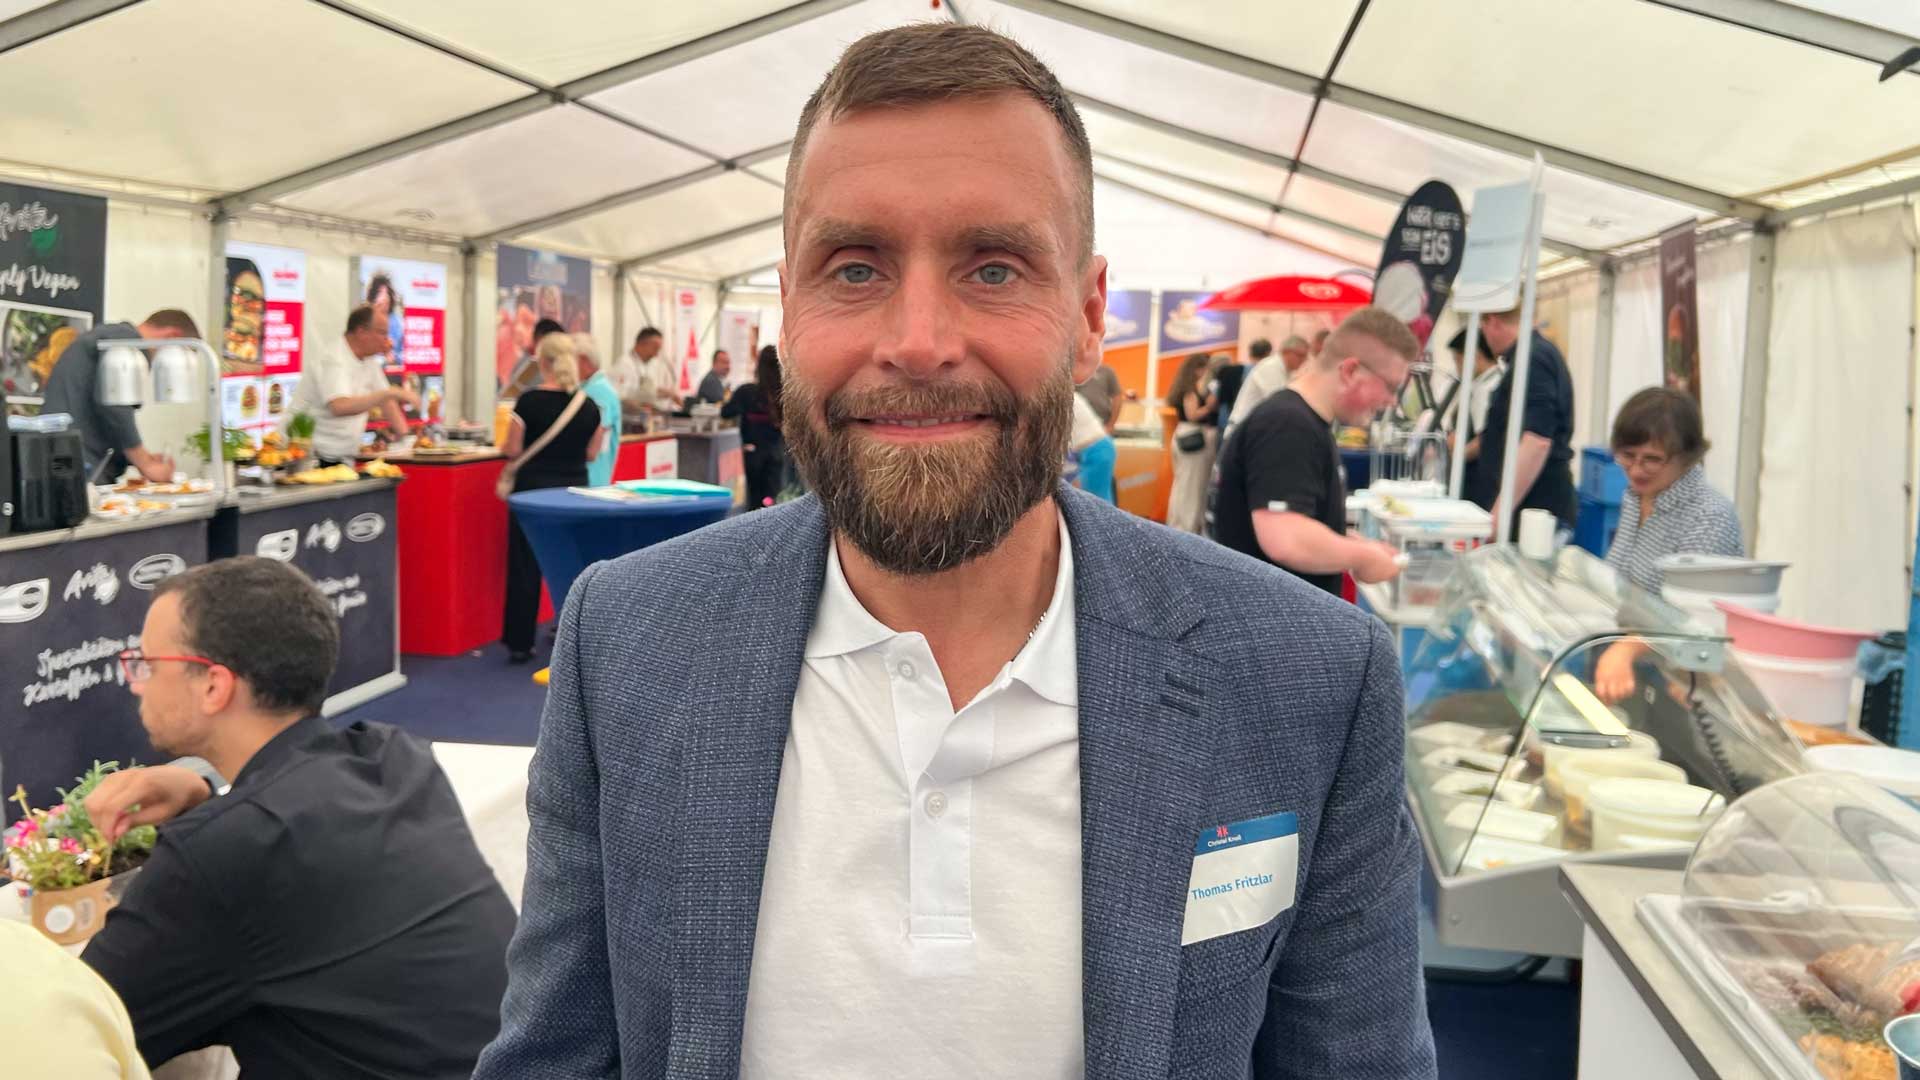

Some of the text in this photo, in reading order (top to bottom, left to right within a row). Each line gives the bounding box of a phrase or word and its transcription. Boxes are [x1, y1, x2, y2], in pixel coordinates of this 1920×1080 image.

[27, 265, 80, 298] Vegan
[1191, 872, 1274, 900] Thomas Fritzlar
